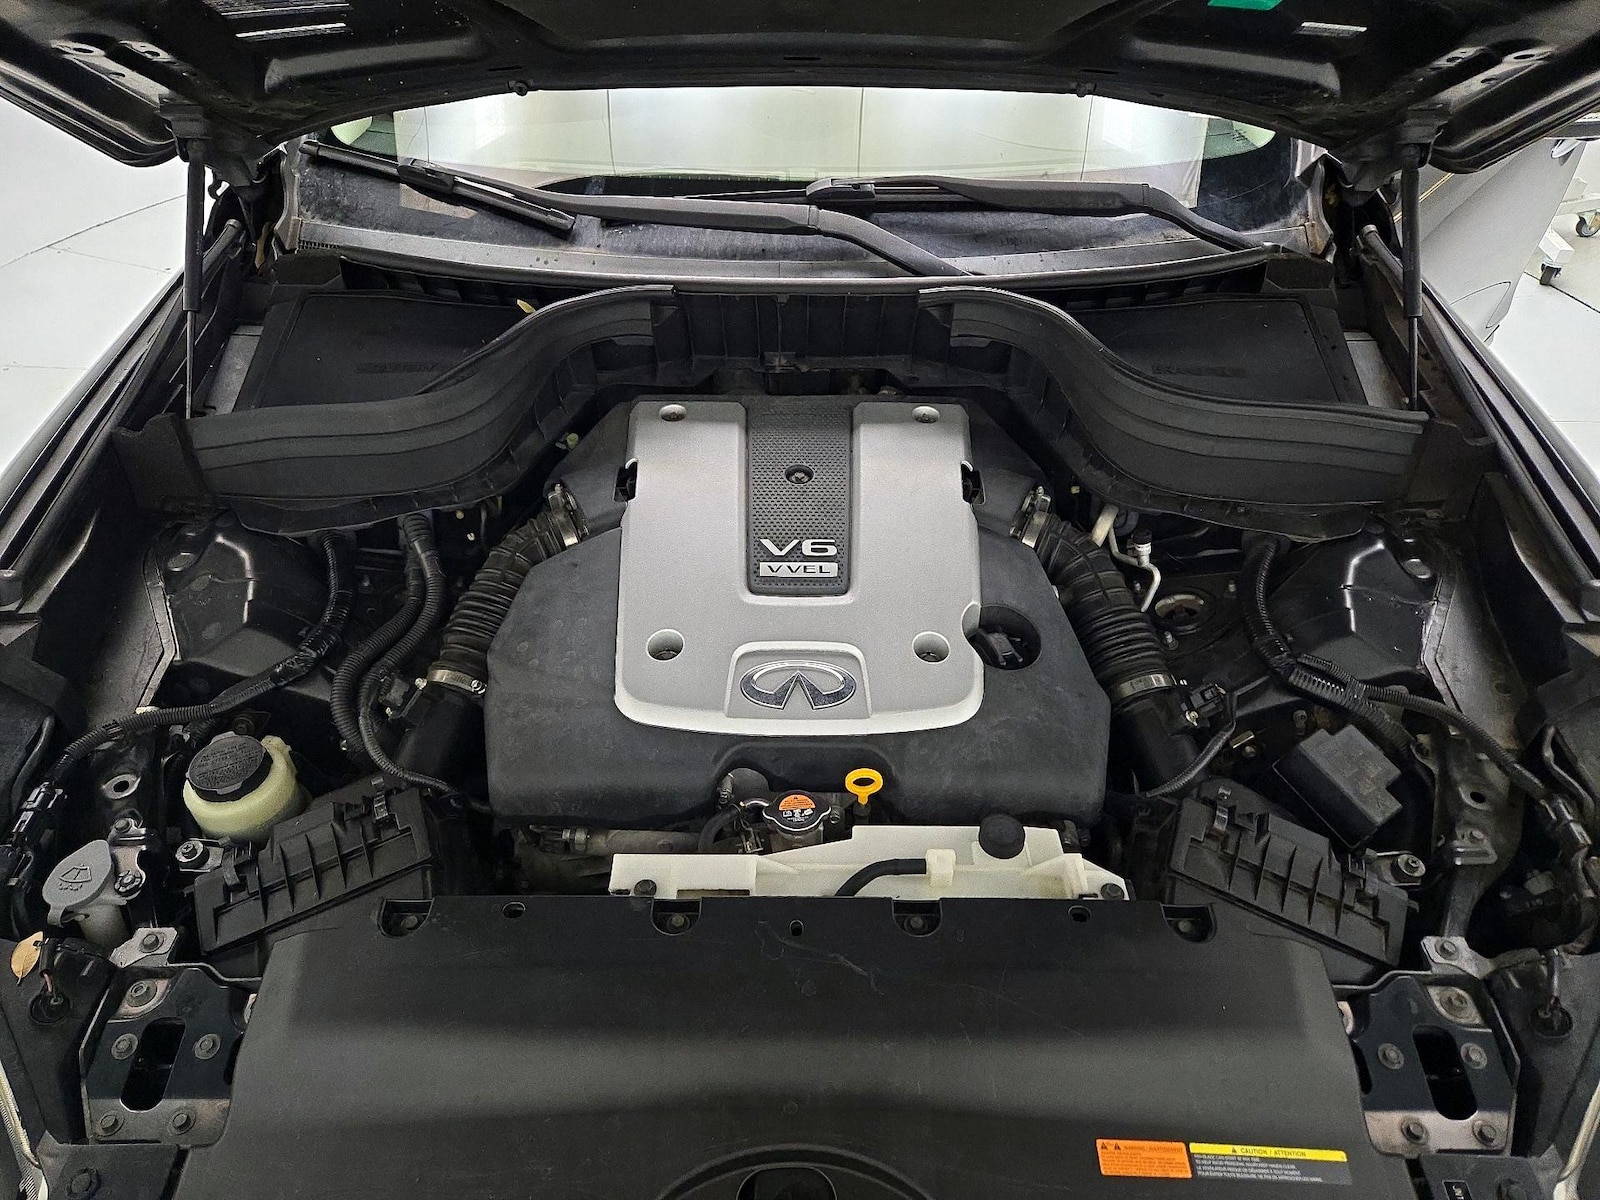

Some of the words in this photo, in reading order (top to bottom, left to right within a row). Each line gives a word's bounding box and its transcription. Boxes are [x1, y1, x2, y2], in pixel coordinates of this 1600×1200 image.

[760, 539, 838, 556] V6
[767, 565, 831, 574] VVEL
[1240, 1147, 1268, 1155] CAUTION
[1274, 1149, 1307, 1157] ATTENTION
